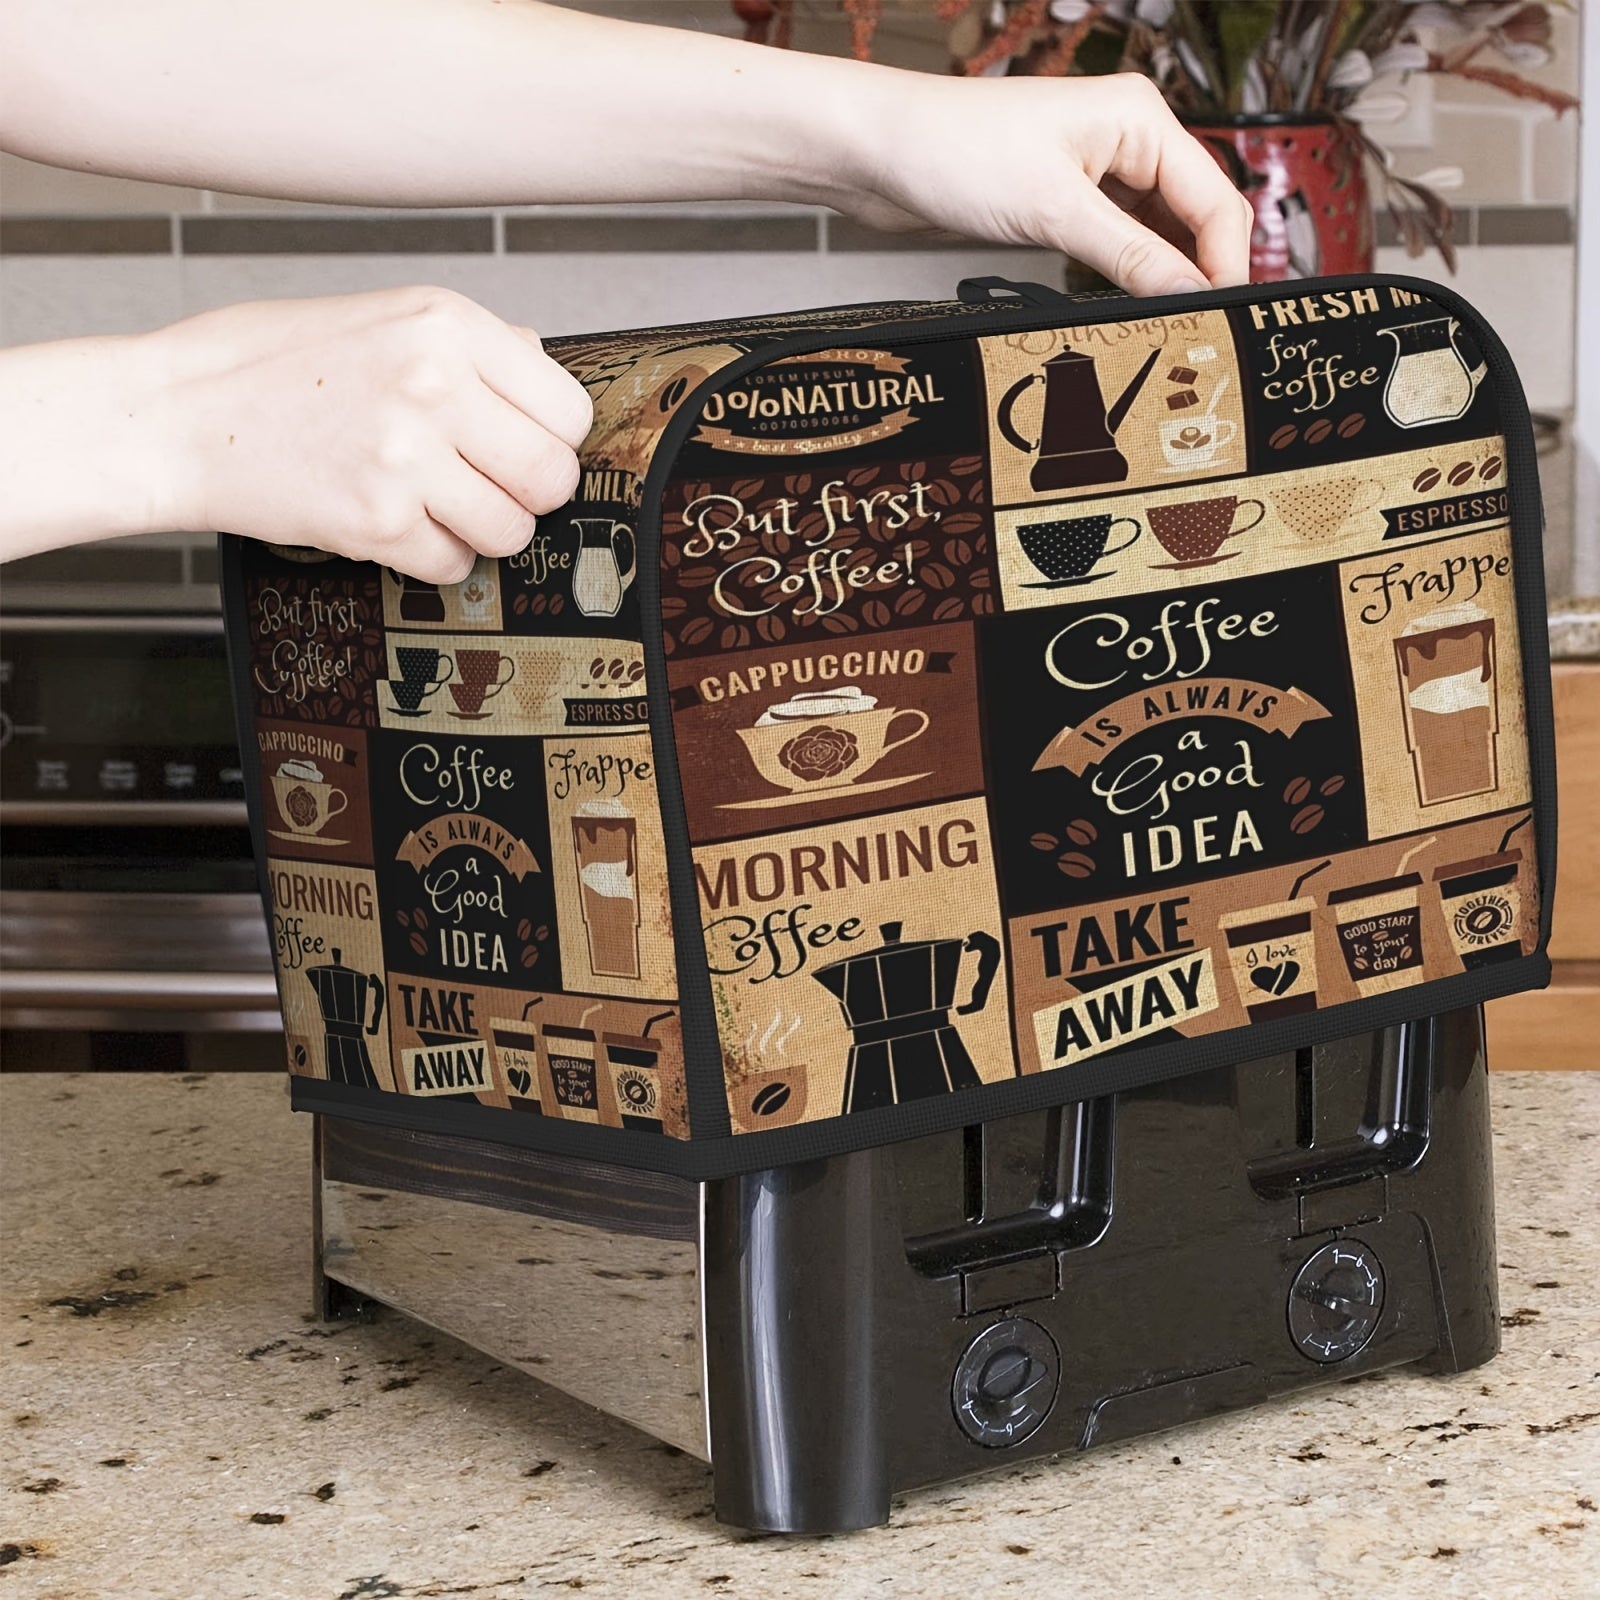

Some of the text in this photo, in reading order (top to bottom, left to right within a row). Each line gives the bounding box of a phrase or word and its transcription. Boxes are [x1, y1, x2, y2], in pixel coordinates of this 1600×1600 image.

[1248, 287, 1380, 330] FRESH
[1262, 333, 1319, 378] for
[1263, 354, 1381, 413] coffee
[583, 471, 639, 503] MILK
[682, 480, 942, 558] But first,
[1397, 493, 1507, 532] ESPRESSO
[509, 536, 571, 585] coffee
[714, 542, 915, 616] Coffee!
[257, 587, 362, 638] But first,
[1349, 553, 1511, 625] Frappe
[1045, 598, 1280, 691] Coffee
[699, 648, 926, 703] CAPPUCCINO
[571, 701, 649, 723] ESPRESSO
[1080, 685, 1279, 748] IS ALWAYS
[257, 731, 344, 763] CAPPUCCINO
[1177, 729, 1209, 751] a
[399, 743, 515, 812] Coffee
[548, 748, 652, 800] Frappe
[1091, 740, 1265, 820] Good
[418, 819, 515, 861] IS ALWAYS
[694, 818, 980, 910] MORNING
[1122, 809, 1264, 878] IDEA
[464, 857, 480, 876] a
[424, 868, 509, 923] Good
[1454, 894, 1510, 919] TOGETHER
[439, 927, 509, 973] IDEA
[701, 903, 866, 985] Coffee
[1030, 895, 1195, 979] TAKE
[1343, 914, 1415, 941] GOOD START
[1353, 933, 1409, 958] to your
[1460, 922, 1513, 946] FOREVER
[1265, 944, 1297, 963] love
[1372, 955, 1399, 972] day
[398, 984, 479, 1037] TAKE
[1053, 958, 1205, 1061] AWAY
[413, 1047, 485, 1092] AWAY
